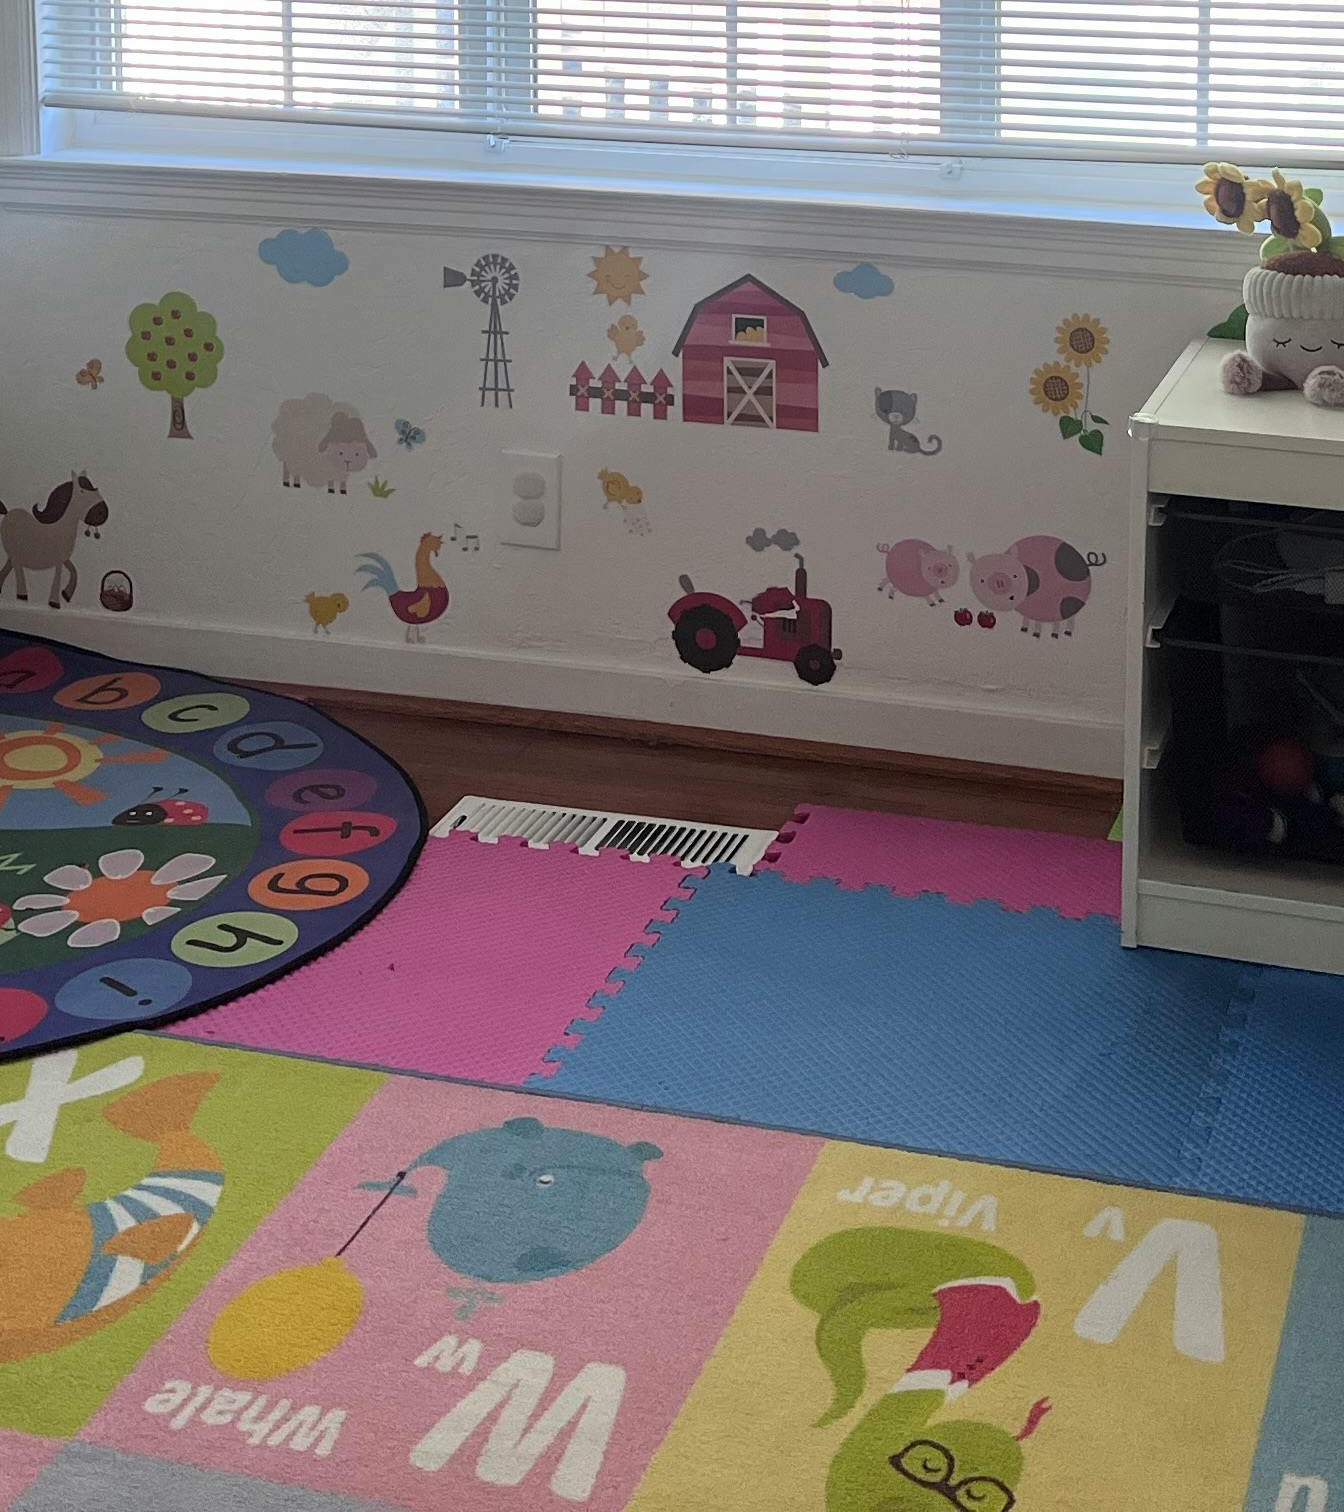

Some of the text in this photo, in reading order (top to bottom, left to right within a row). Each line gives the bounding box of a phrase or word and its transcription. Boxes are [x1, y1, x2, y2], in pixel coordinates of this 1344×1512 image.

[77, 677, 129, 705] b
[167, 703, 219, 723] c
[292, 782, 347, 806] e
[292, 820, 381, 840] f
[266, 872, 350, 898] g
[185, 922, 285, 954] h
[836, 1176, 999, 1233] Viper
[143, 1378, 348, 1458] Whale
